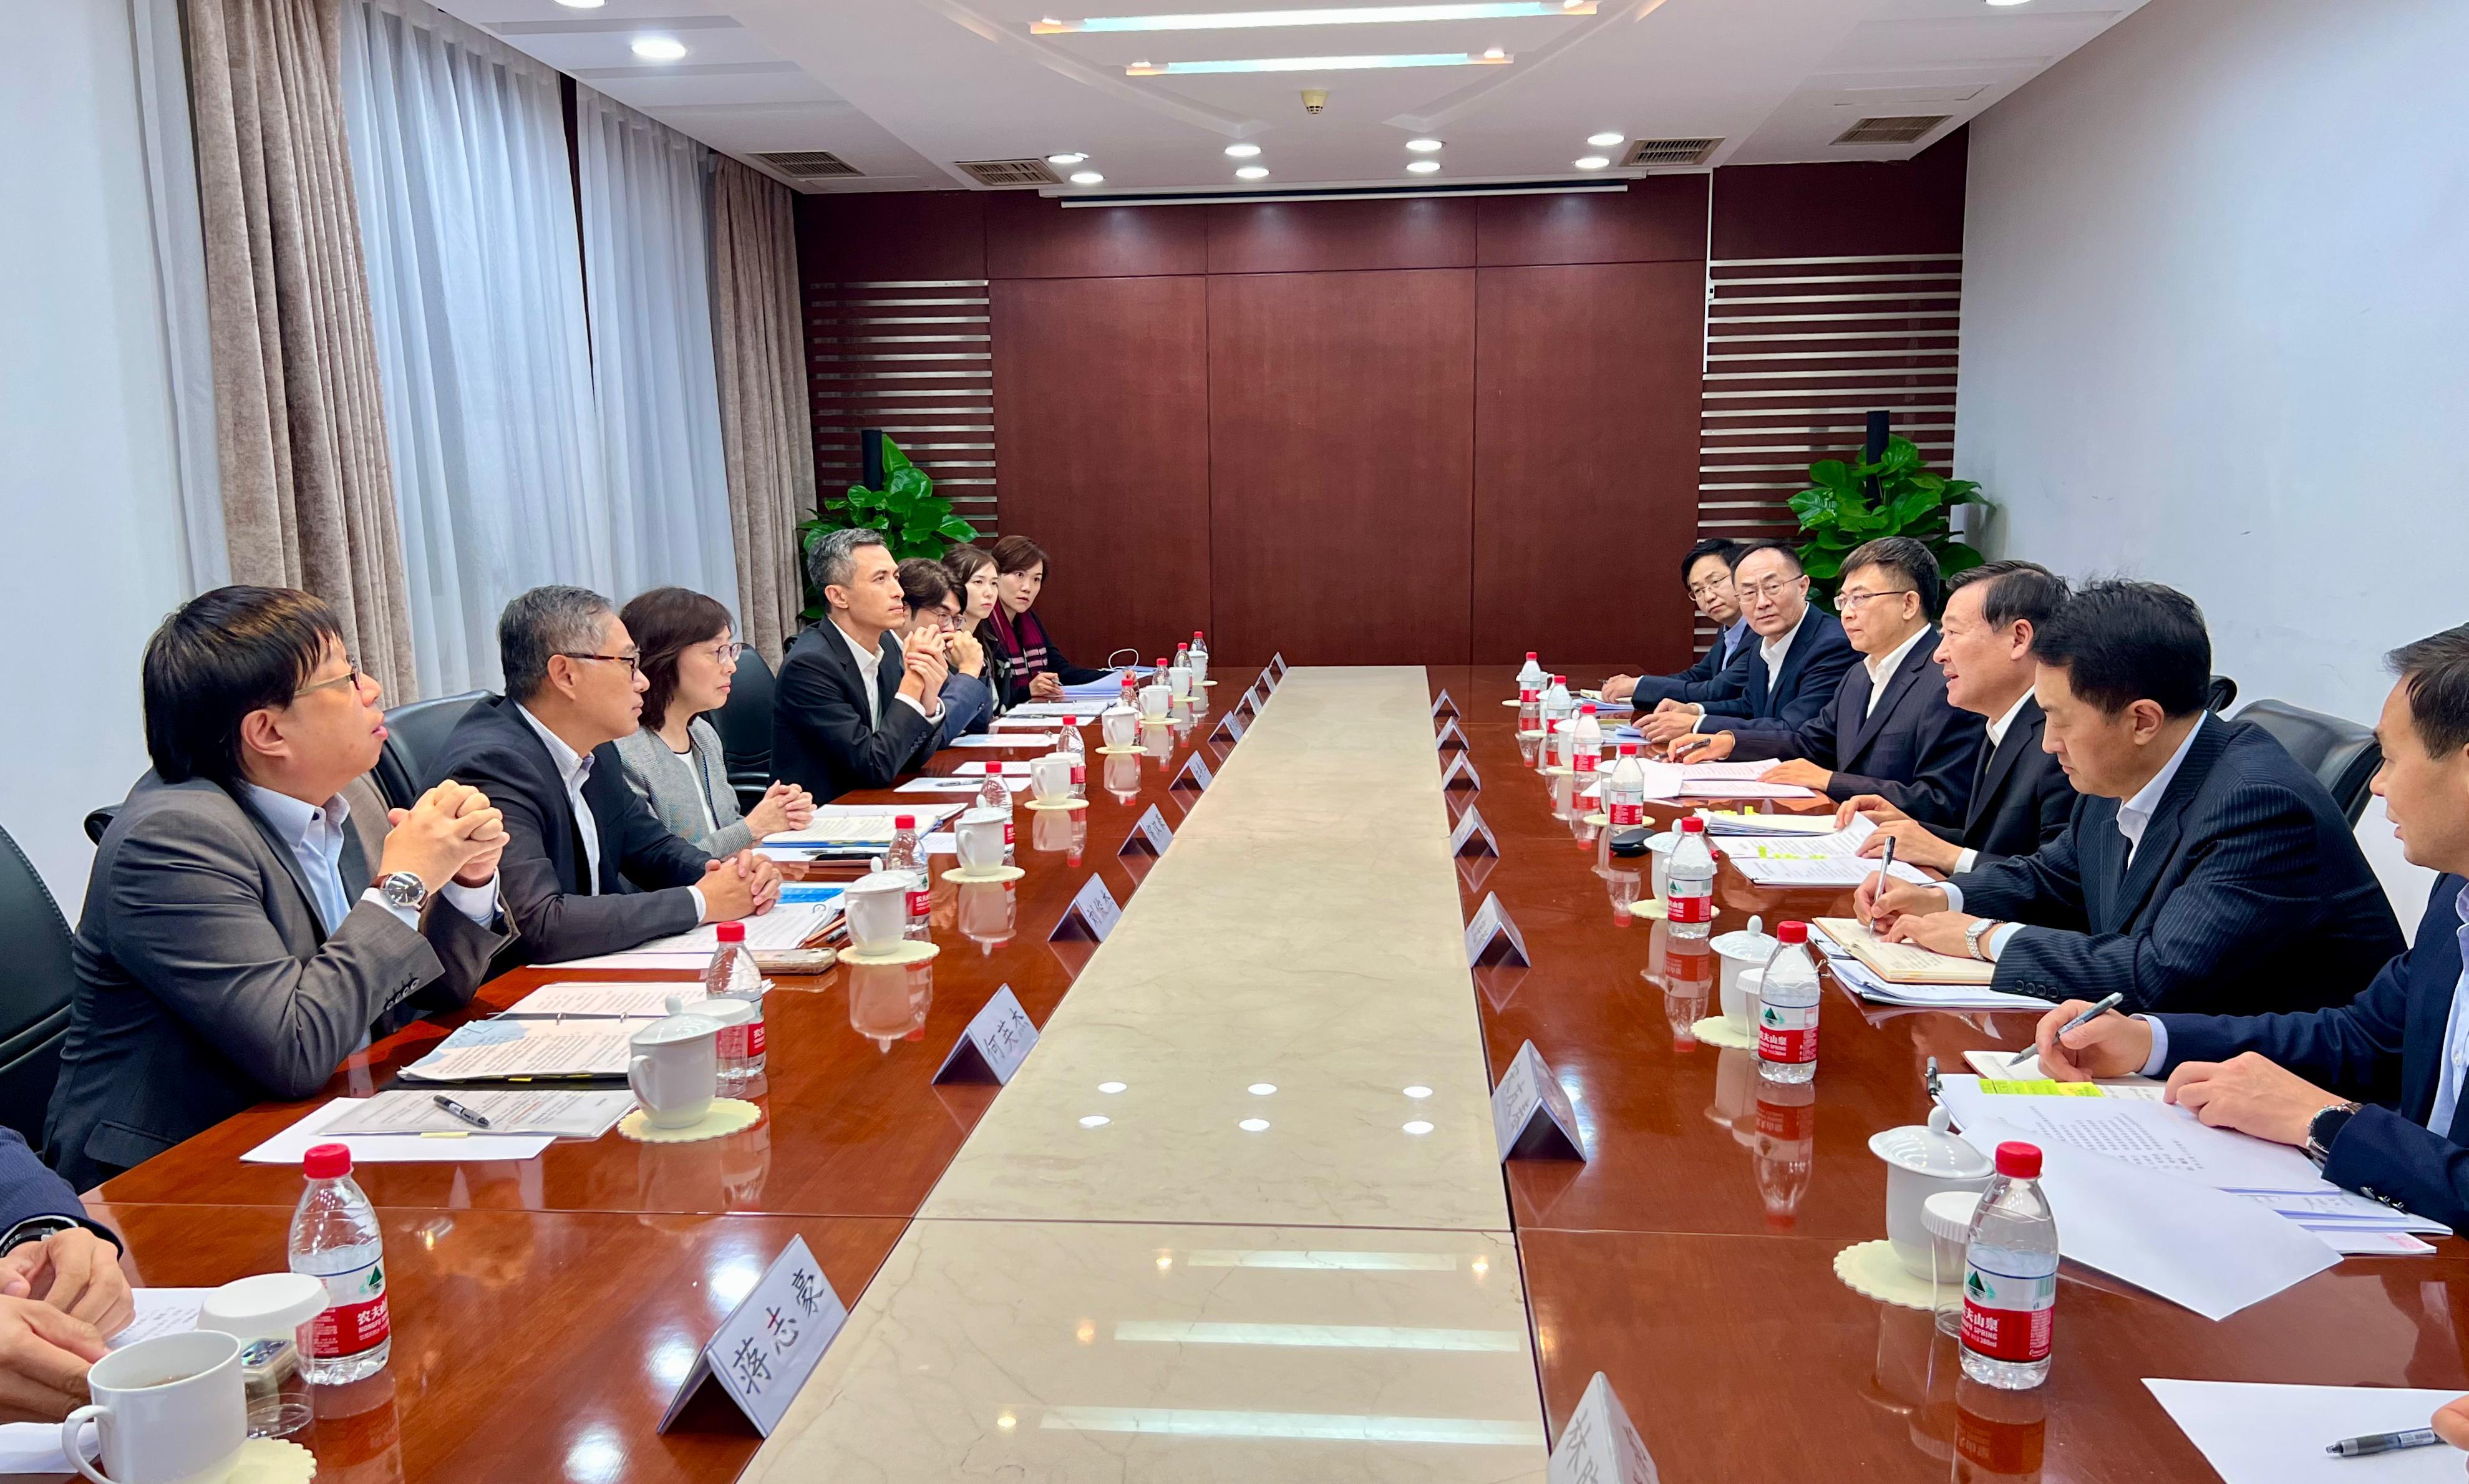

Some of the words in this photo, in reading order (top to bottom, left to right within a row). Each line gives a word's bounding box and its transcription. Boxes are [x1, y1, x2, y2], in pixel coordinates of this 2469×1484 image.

[983, 1007, 1030, 1064] 何英杰
[732, 1268, 825, 1394] 蒋志豪
[1973, 1326, 1998, 1341] SPRING
